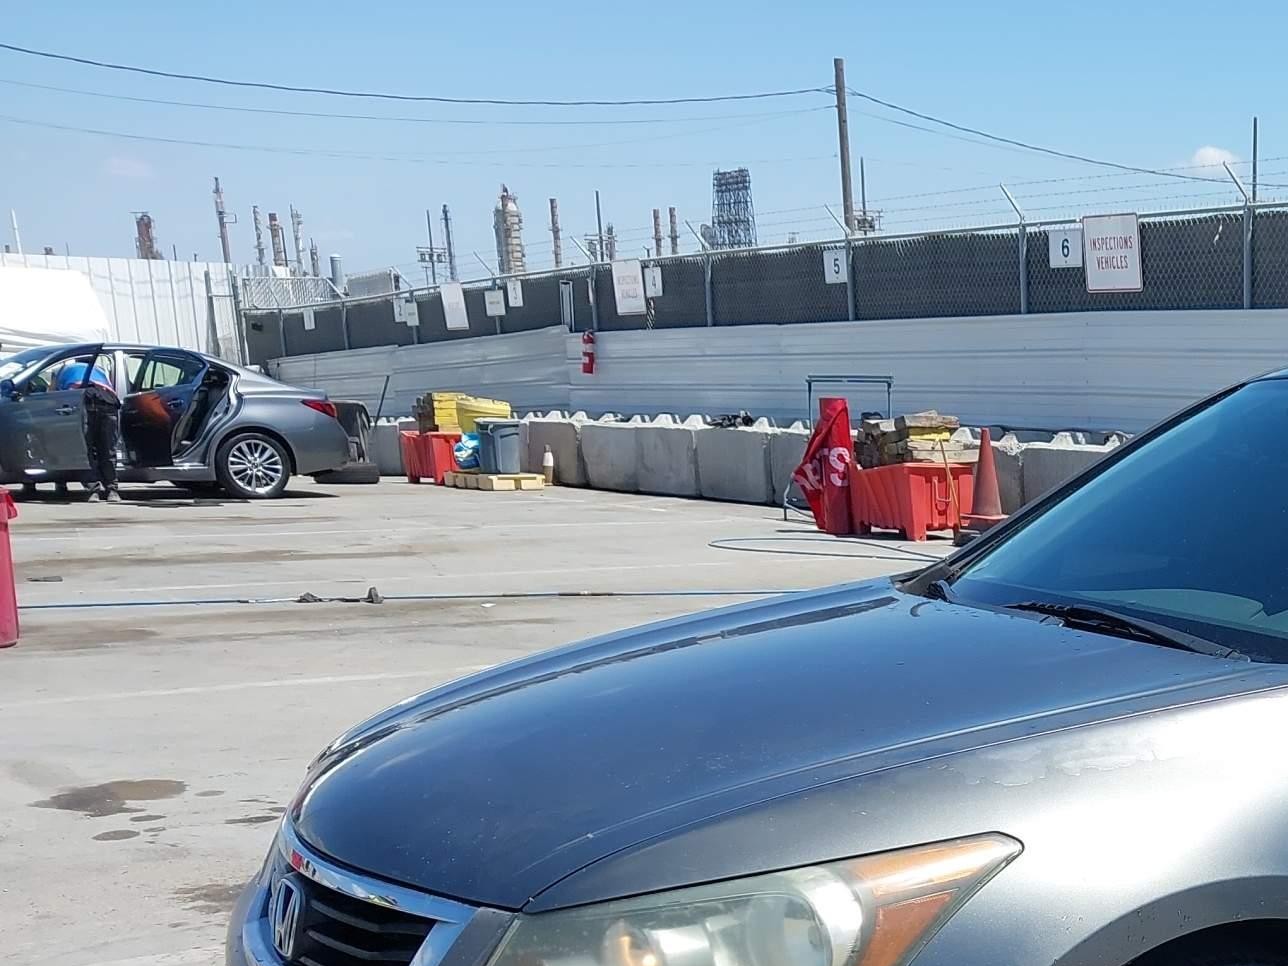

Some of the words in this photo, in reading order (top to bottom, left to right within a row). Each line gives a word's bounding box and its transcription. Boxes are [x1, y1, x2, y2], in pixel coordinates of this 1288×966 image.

[1061, 238, 1070, 258] 6
[1089, 235, 1133, 251] INSPECTIONS
[833, 257, 840, 275] 5
[1096, 255, 1129, 270] VEHICLES
